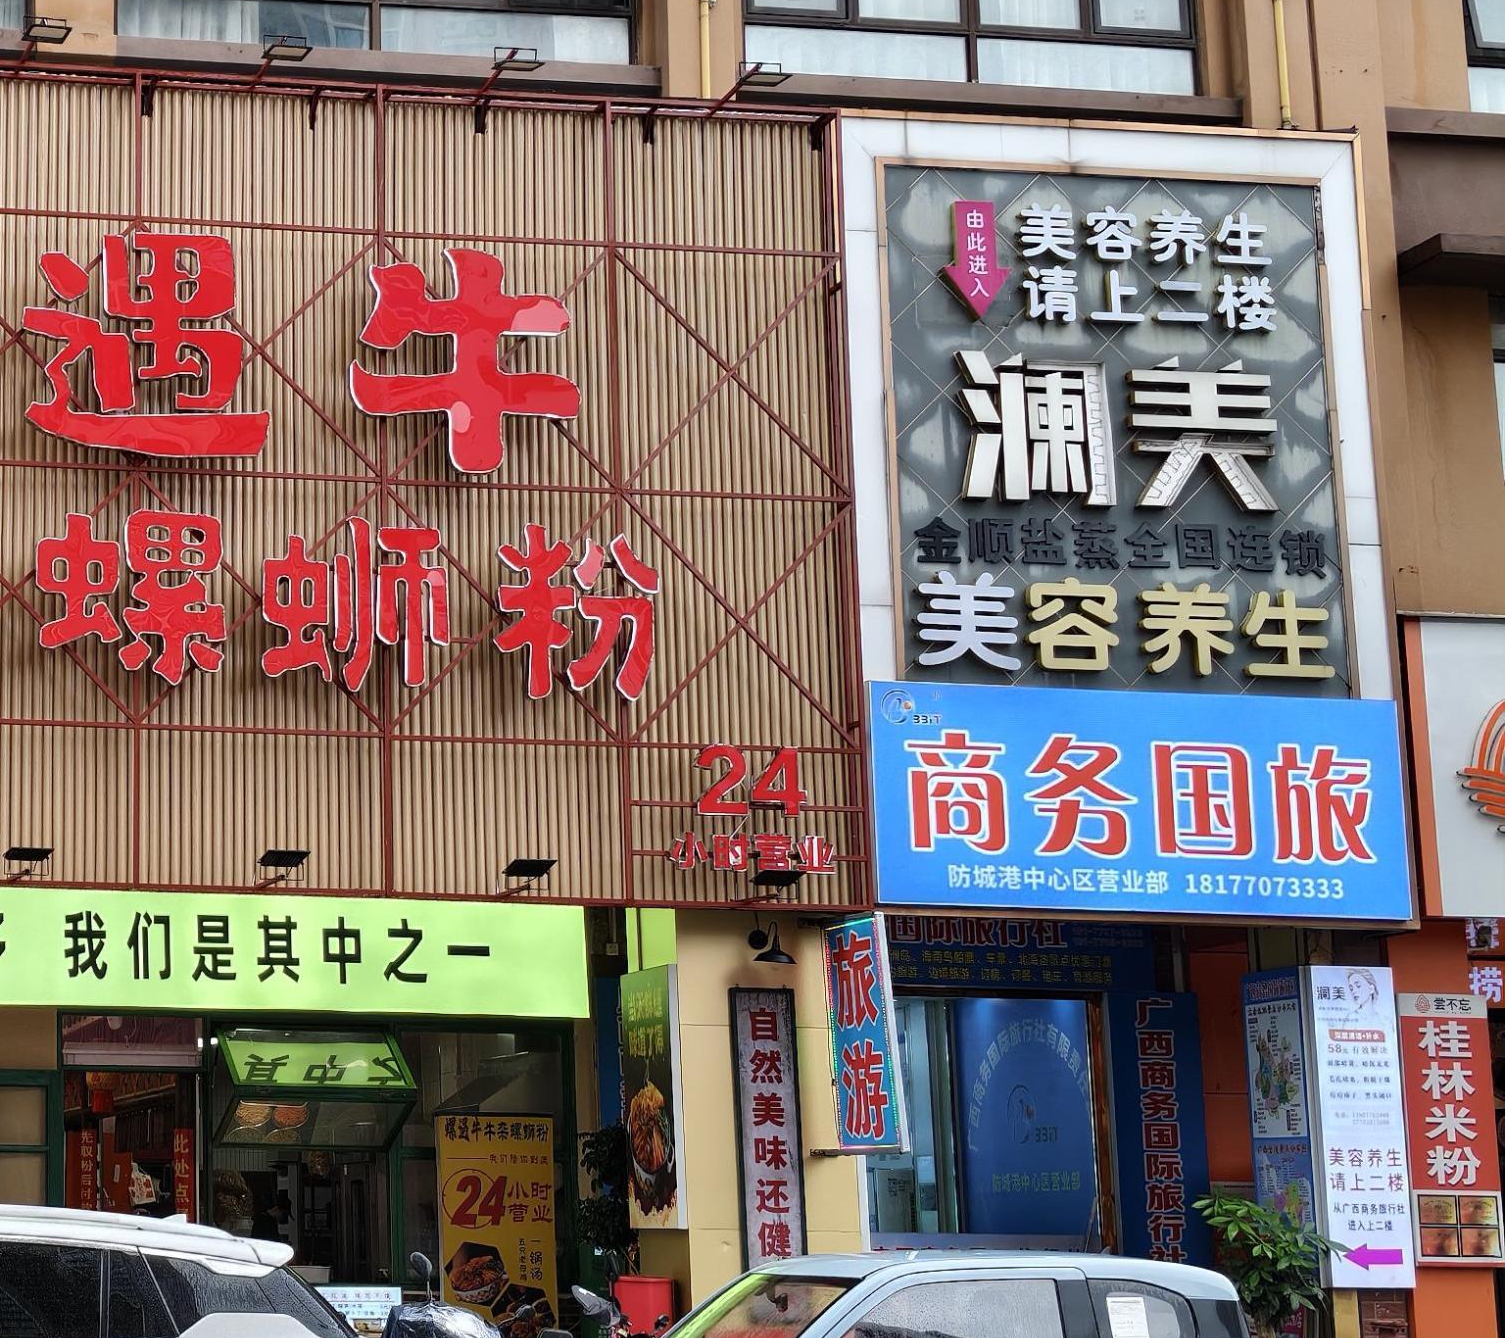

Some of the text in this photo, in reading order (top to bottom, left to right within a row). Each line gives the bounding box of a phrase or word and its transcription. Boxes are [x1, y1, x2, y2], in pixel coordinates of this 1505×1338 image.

[964, 209, 989, 299] 由此进入
[1018, 203, 1274, 268] 美容养生
[1021, 264, 1279, 333] 请上二楼
[952, 349, 1279, 512] 澜美
[914, 516, 1327, 579] 金顺盐蒸全国连锁
[914, 571, 1336, 681] 美容养生
[695, 743, 808, 817] 24
[904, 731, 1374, 863] 商务国旅
[670, 831, 836, 874] 小时营业
[948, 864, 1345, 900] 防城港中心区营业部 18177073333
[64, 911, 491, 988] 我们是其中之一
[1316, 985, 1346, 1001] 澜美
[1433, 997, 1472, 1012] 尝不忘
[832, 930, 890, 1140] 旅游
[749, 1007, 793, 1259] 自然美味还健
[1135, 998, 1187, 1263] 广西商务国际旅行社
[1418, 1020, 1482, 1187] 桂林米粉
[174, 1133, 190, 1212] 此处点
[1328, 1147, 1403, 1168] 美容养生
[1329, 1173, 1404, 1193] 请上二楼
[451, 1175, 508, 1226] 24
[507, 1181, 552, 1201] 小时
[507, 1203, 552, 1224] 营业
[1333, 1202, 1406, 1216] 从广西商务旅行社
[1348, 1219, 1394, 1232] 进入上二楼
